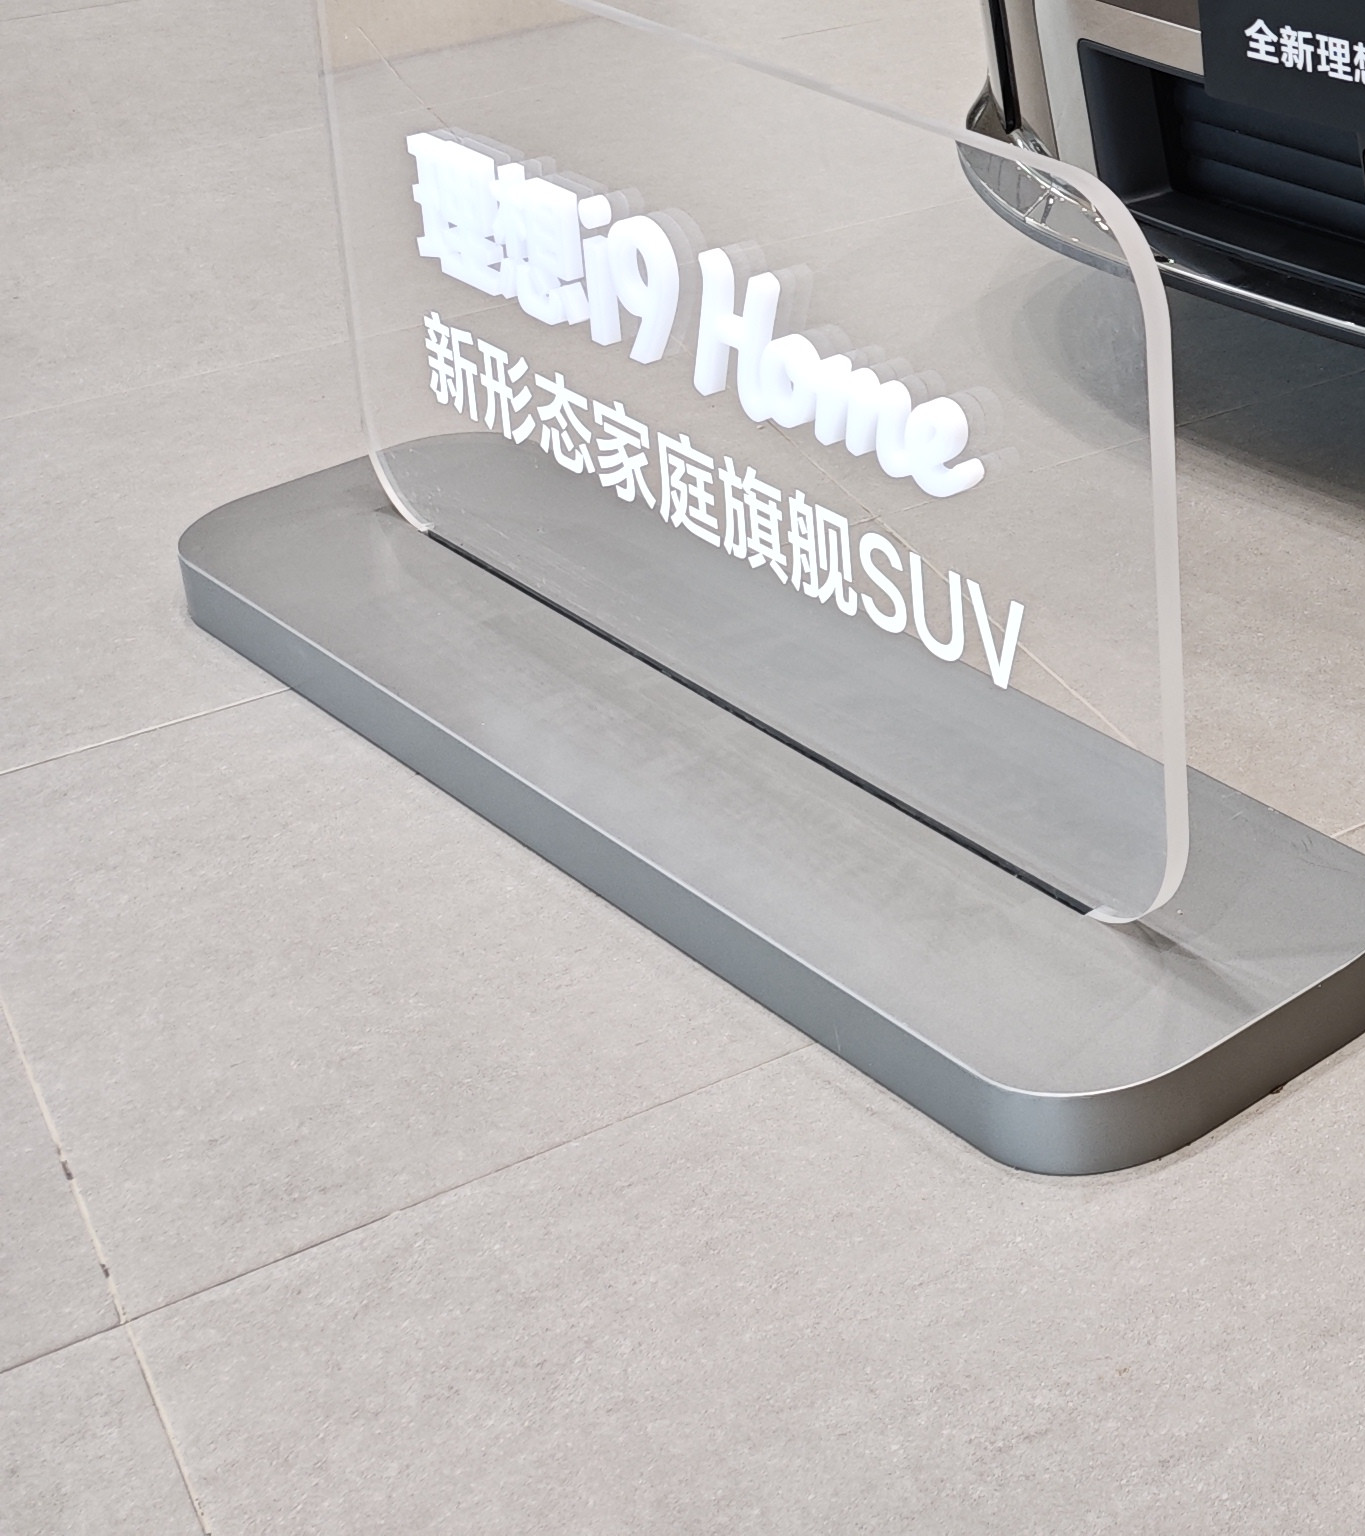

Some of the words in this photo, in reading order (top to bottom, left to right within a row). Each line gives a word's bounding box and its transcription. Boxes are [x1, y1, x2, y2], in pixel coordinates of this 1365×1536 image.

[406, 131, 681, 365] 理想i9
[692, 247, 987, 499] Home
[423, 311, 1025, 690] 新形态家庭旗舰SUV
